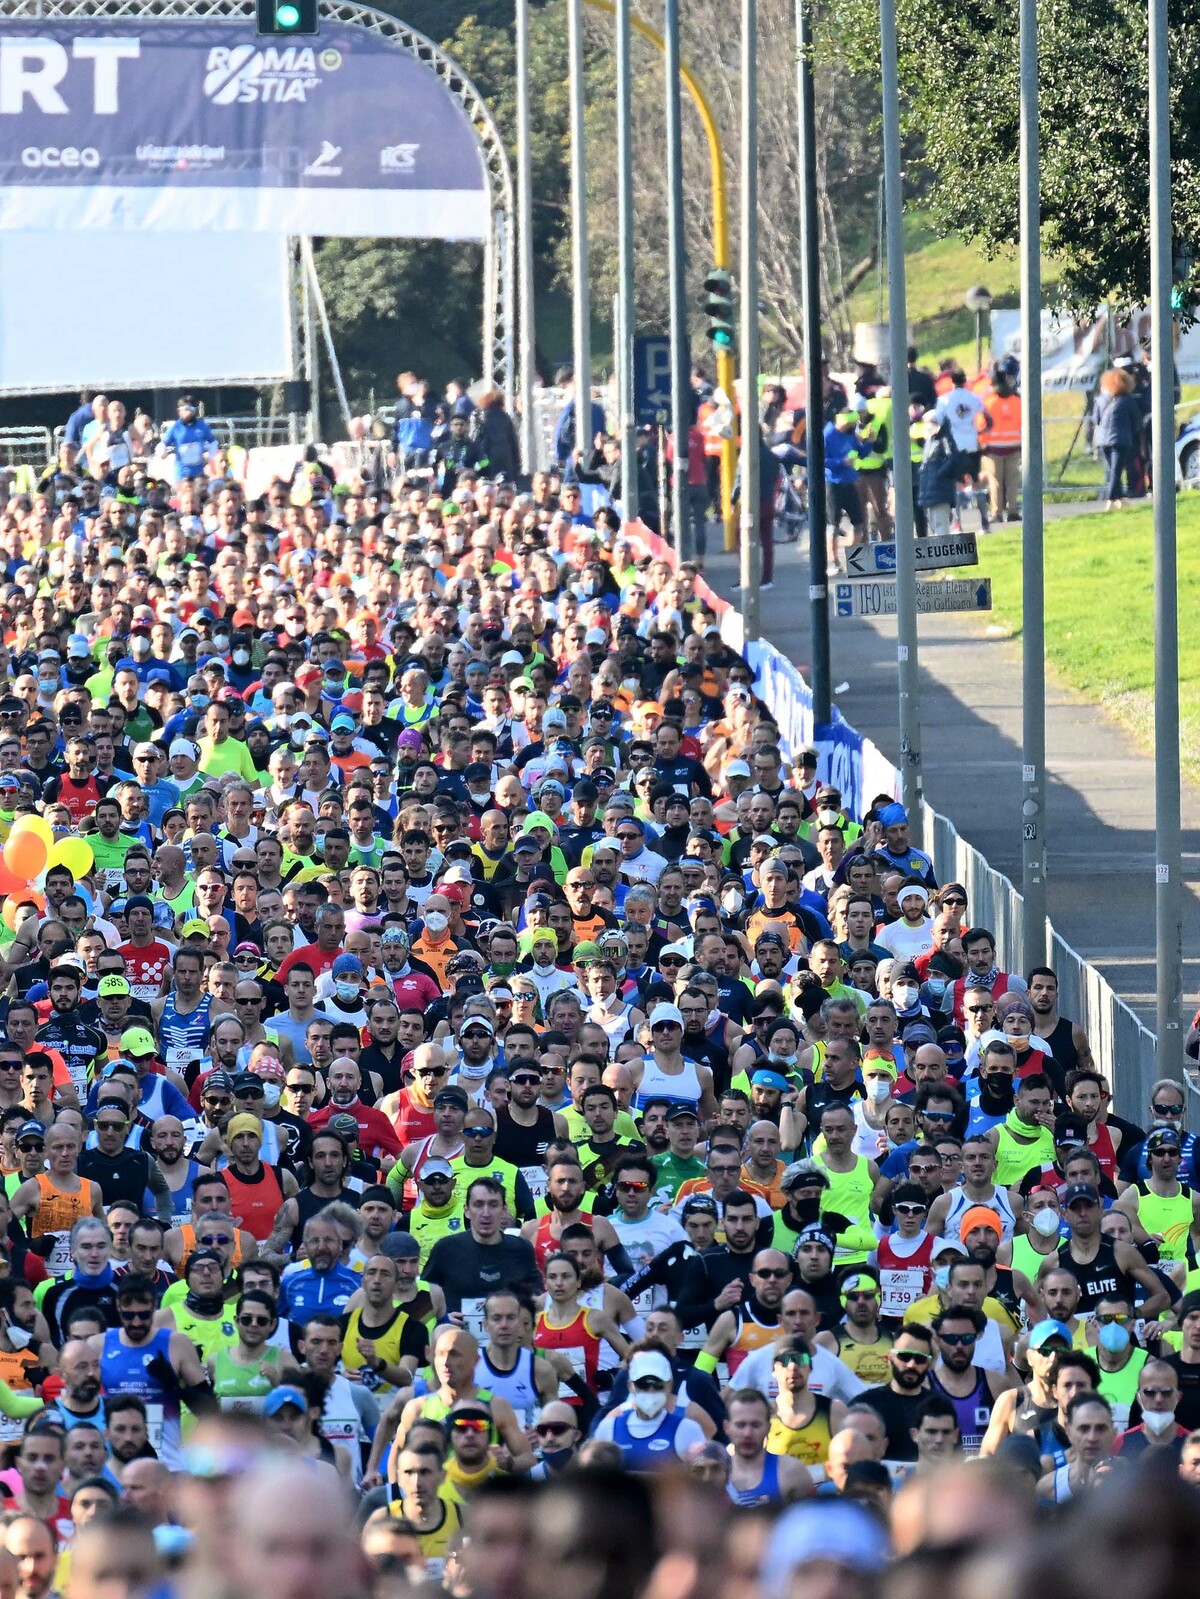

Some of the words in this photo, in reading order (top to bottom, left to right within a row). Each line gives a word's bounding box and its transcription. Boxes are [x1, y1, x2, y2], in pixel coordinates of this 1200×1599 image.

[646, 343, 672, 390] P
[915, 548, 926, 559] S.
[928, 542, 975, 558] EUGENIO
[916, 581, 943, 597] Regina
[946, 581, 968, 594] Elena
[859, 583, 881, 614] IFO
[917, 599, 931, 611] San
[934, 598, 971, 610] Gallicano
[1087, 1278, 1117, 1296] ELITE
[890, 1292, 911, 1304] F39
